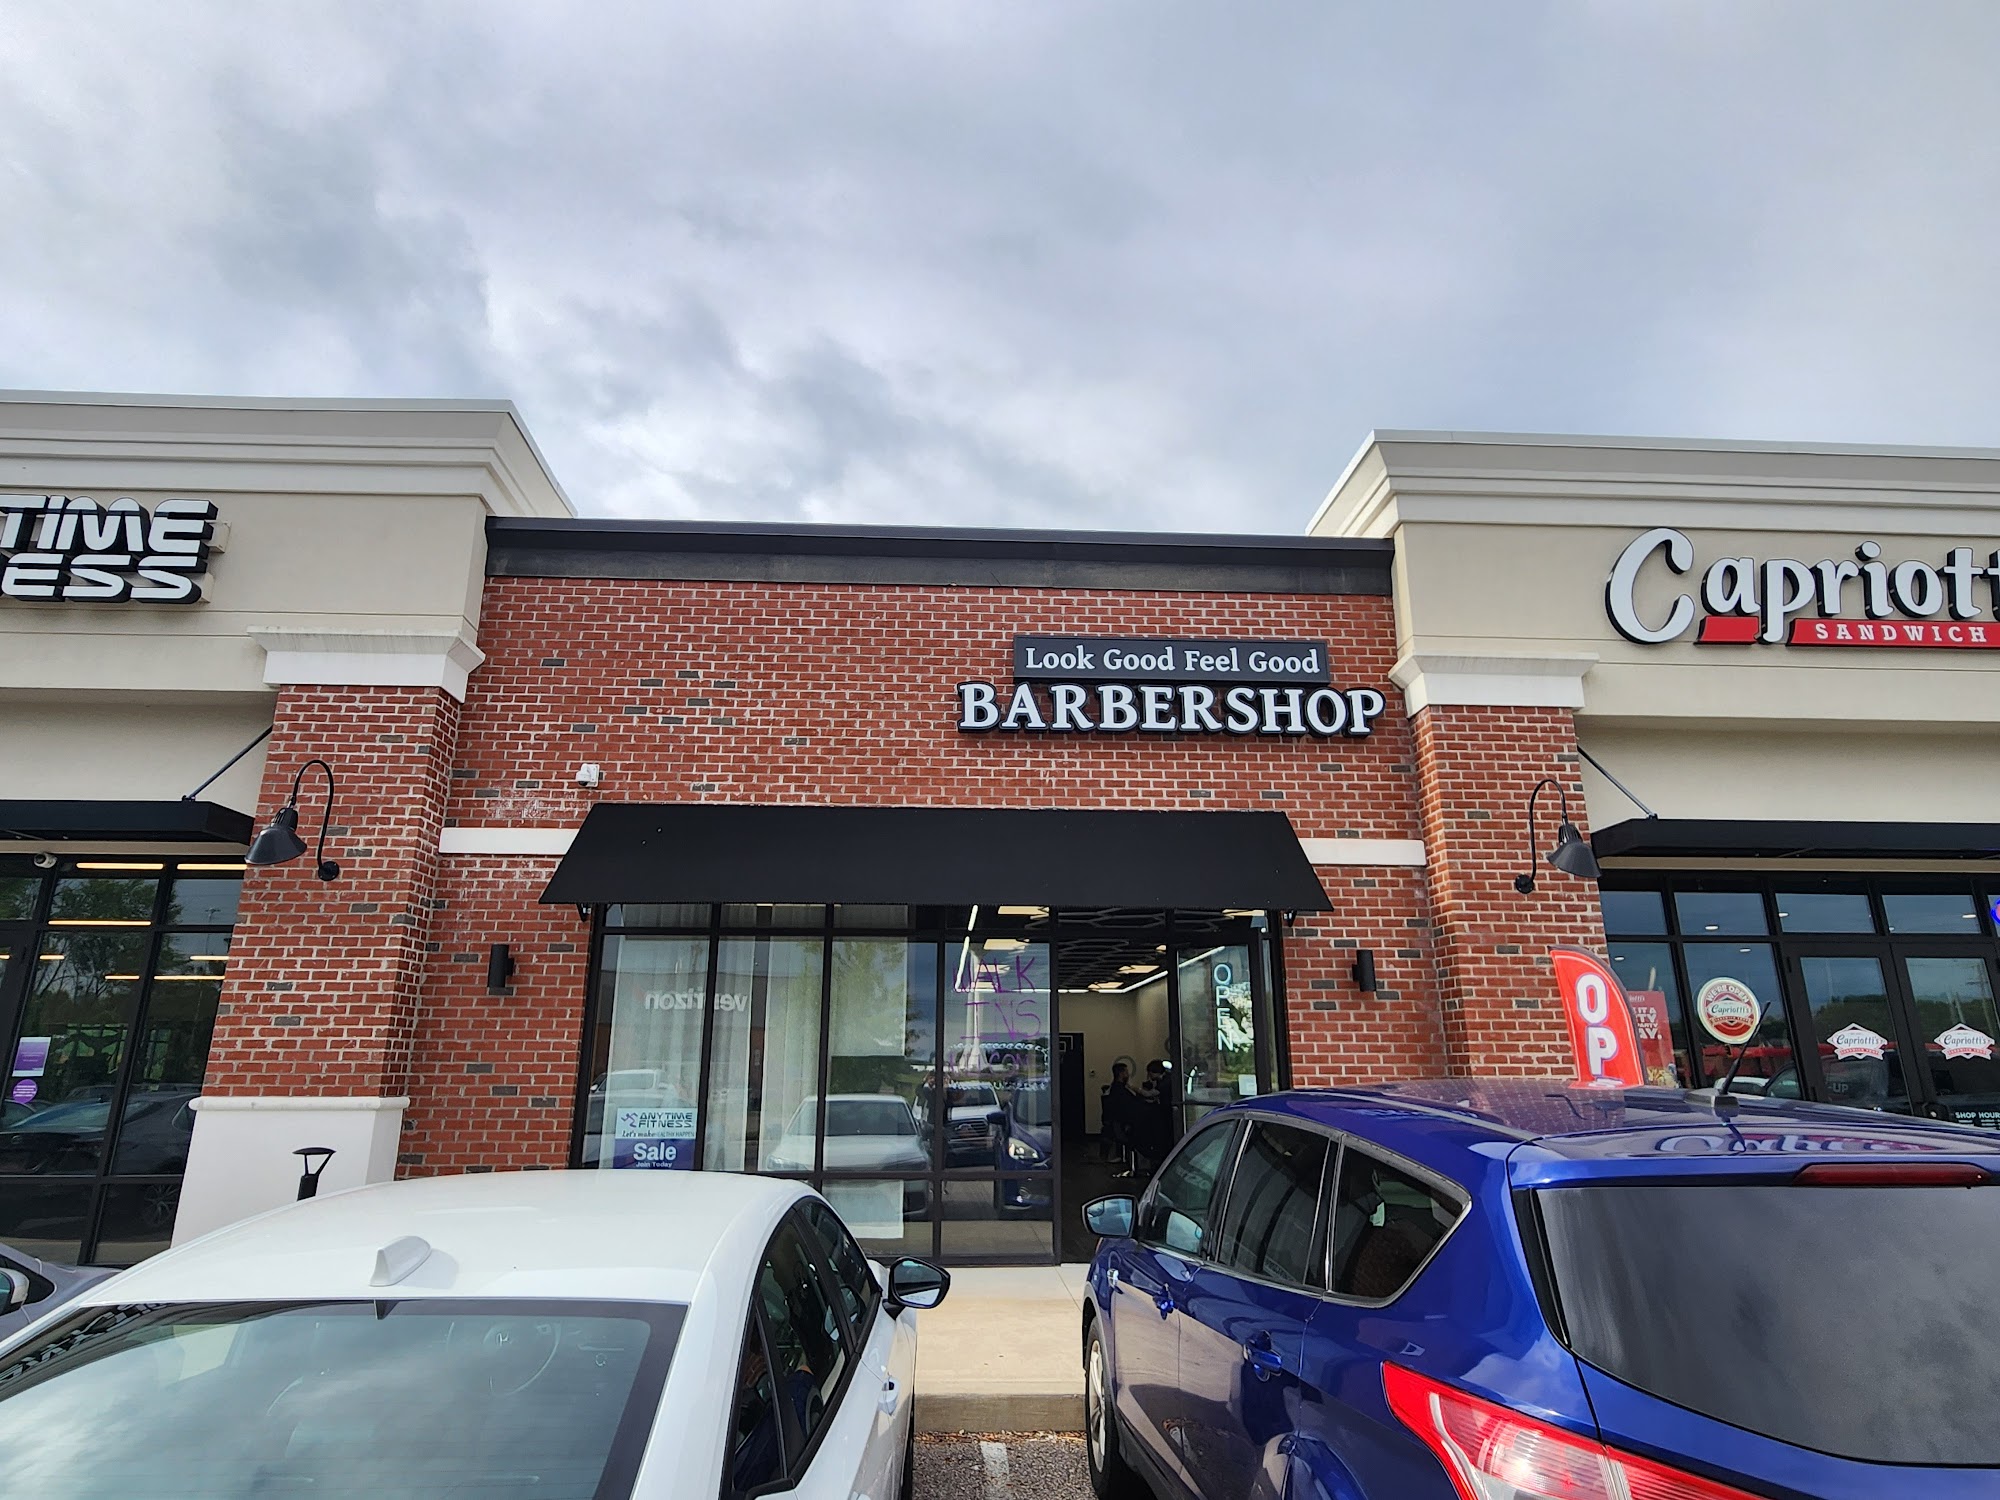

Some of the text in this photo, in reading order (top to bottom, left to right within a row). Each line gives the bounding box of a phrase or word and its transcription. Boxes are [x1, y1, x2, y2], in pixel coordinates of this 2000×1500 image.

[1, 552, 201, 604] ESS
[1815, 623, 1988, 643] SANDWICH
[1025, 645, 1320, 674] Look Good Feel Good
[958, 682, 1385, 737] BARBERSHOP
[1213, 963, 1234, 1051] OPEN
[1576, 972, 1622, 1086] OP
[1836, 1034, 1879, 1047] Capriotti's
[1943, 1034, 1986, 1047] Capriotti's
[638, 1120, 693, 1128] FITNESS
[640, 1112, 693, 1120] ANYTIME
[633, 1142, 677, 1161] Sale
